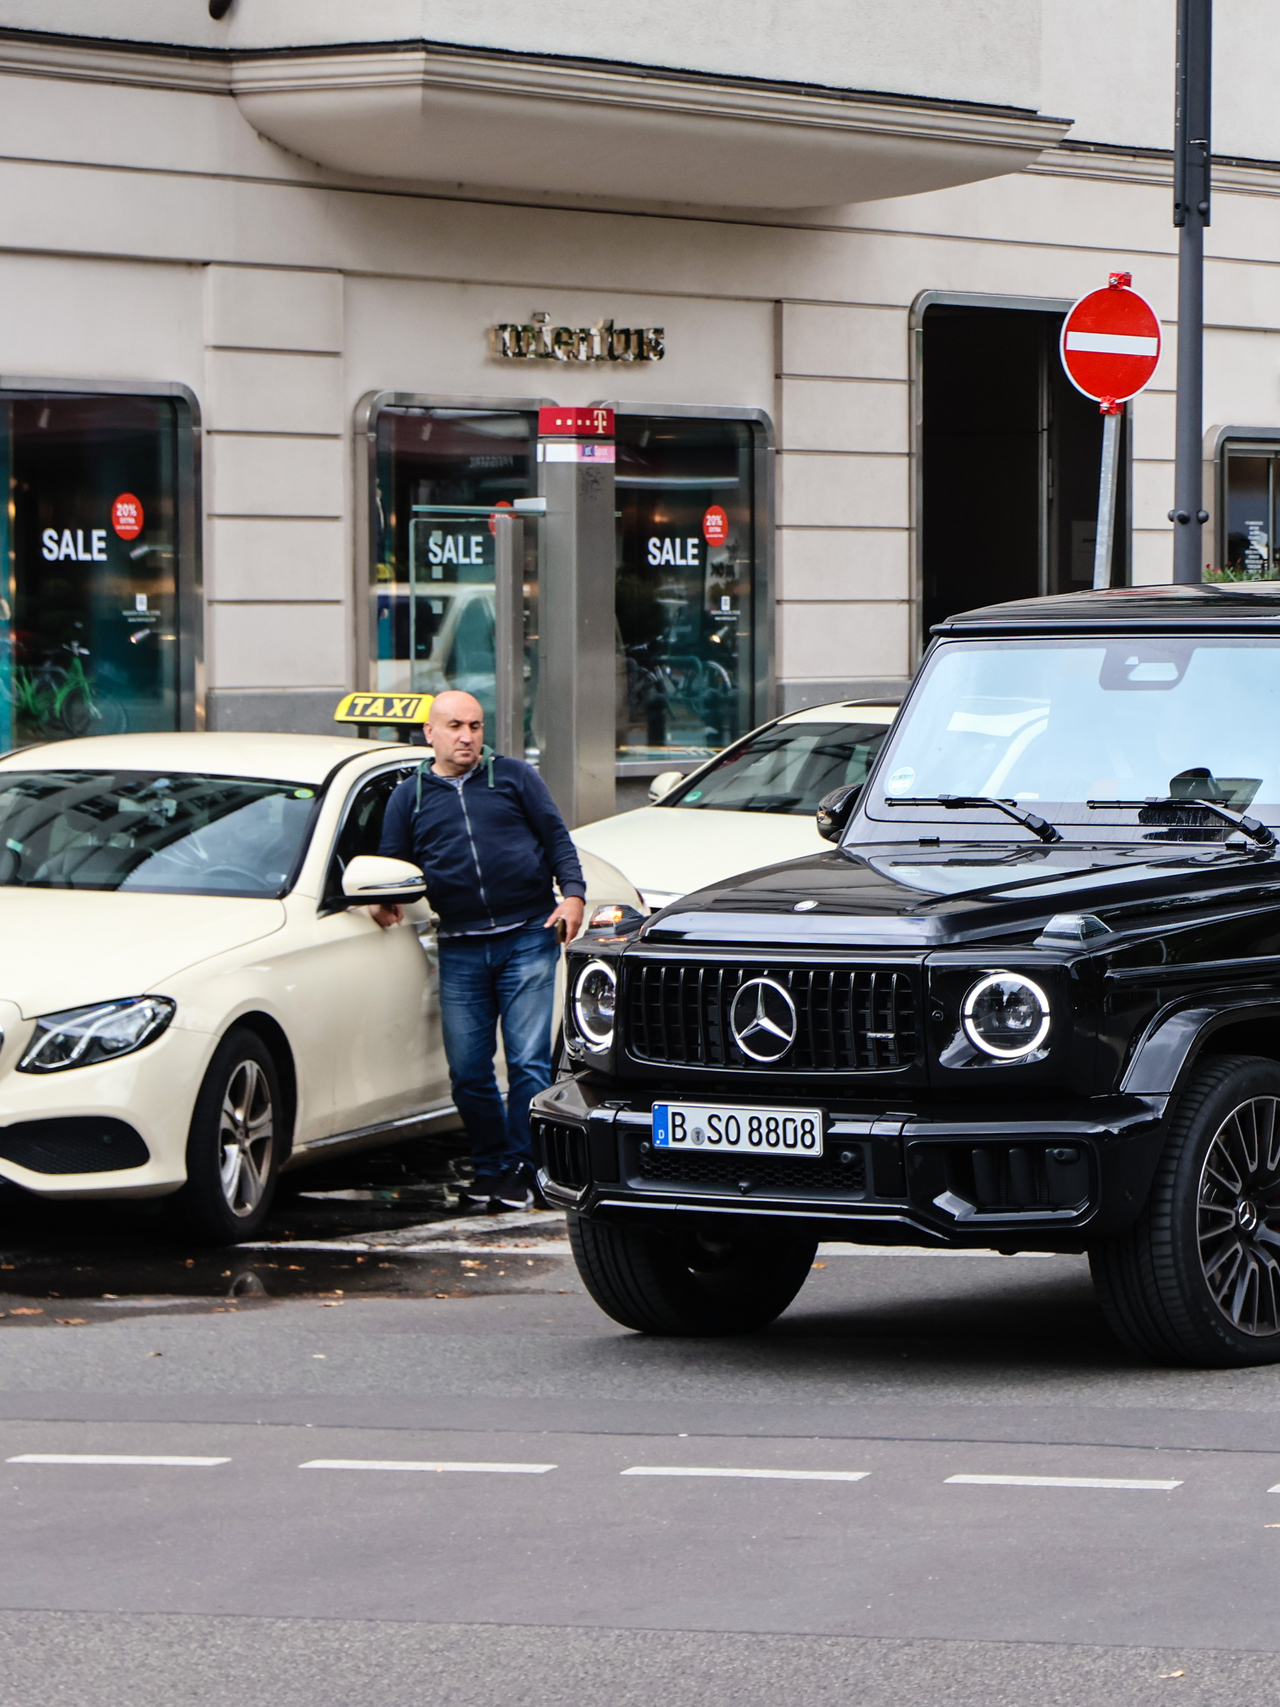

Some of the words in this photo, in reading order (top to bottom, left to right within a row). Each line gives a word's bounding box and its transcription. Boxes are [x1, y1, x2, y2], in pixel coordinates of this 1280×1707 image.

[490, 312, 665, 361] mientus
[116, 503, 138, 517] 20%
[706, 515, 723, 526] 20%
[42, 527, 107, 561] SALE
[428, 535, 483, 565] SALE
[647, 537, 699, 566] SALE
[353, 697, 420, 717] TAXI
[671, 1112, 687, 1142] B
[707, 1114, 741, 1146] SO
[748, 1116, 816, 1149] 8808
